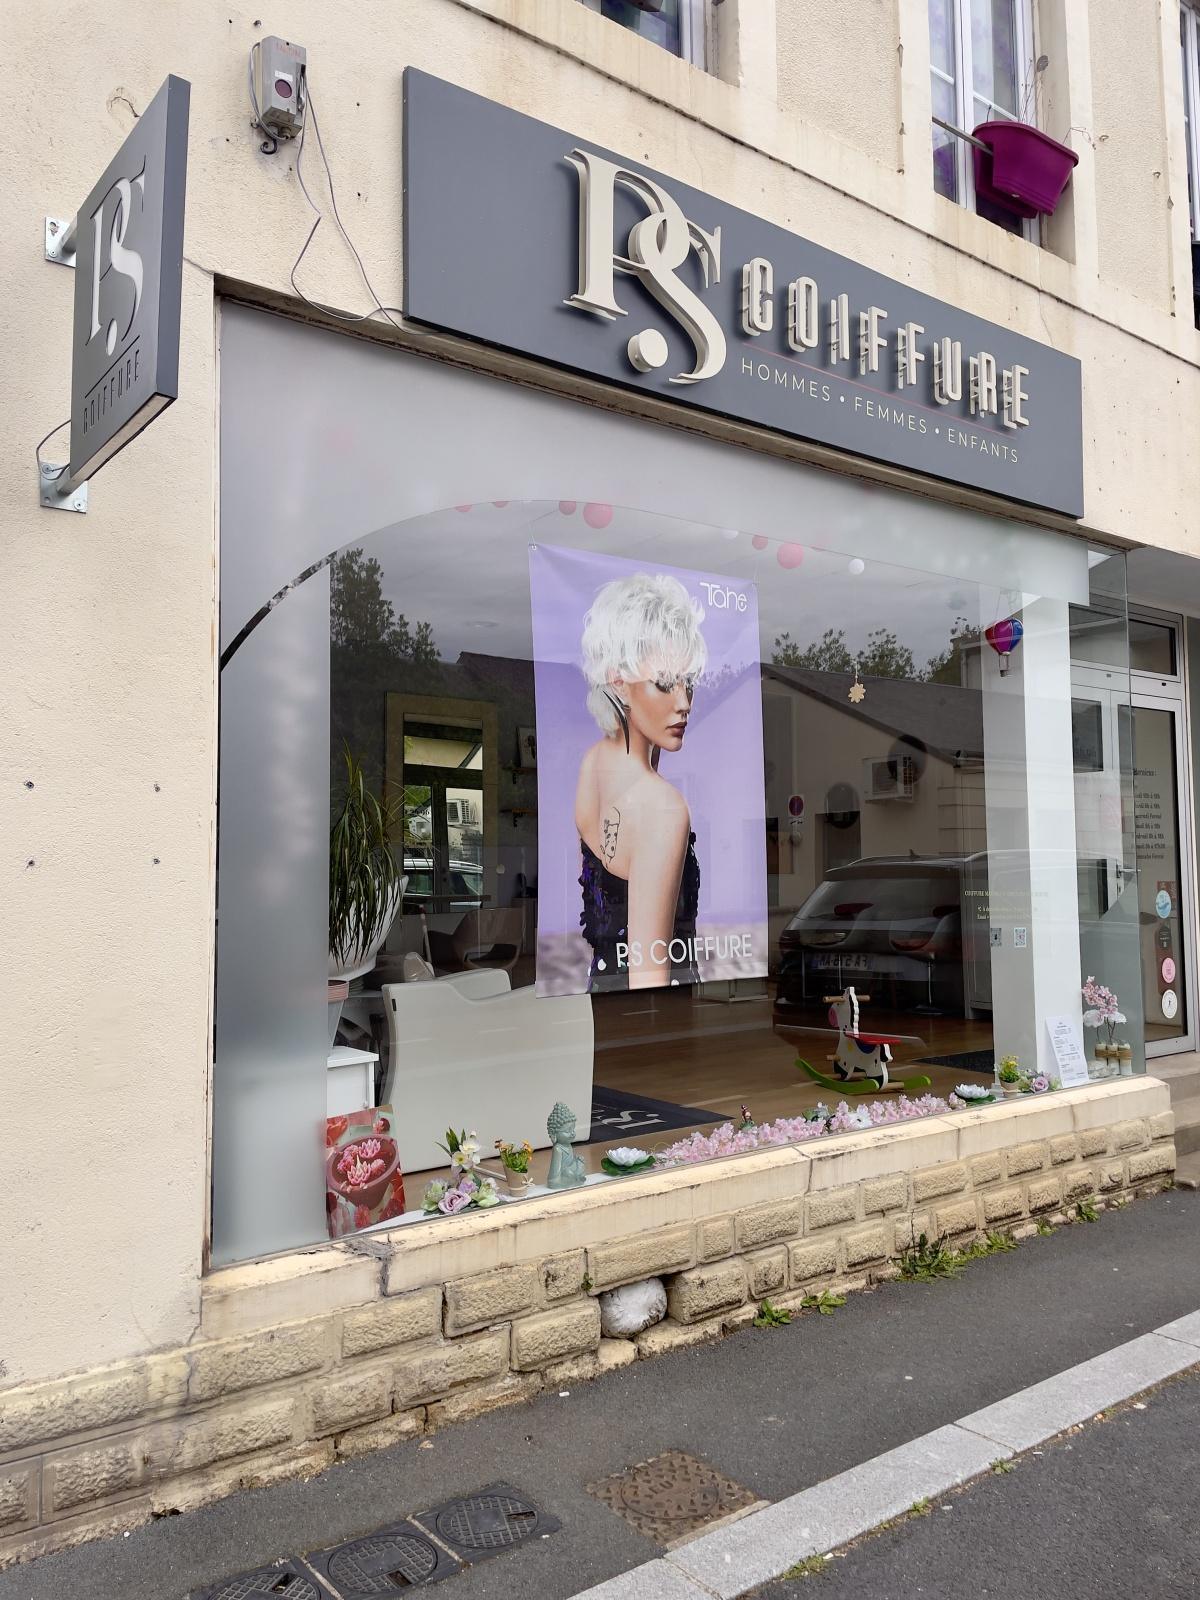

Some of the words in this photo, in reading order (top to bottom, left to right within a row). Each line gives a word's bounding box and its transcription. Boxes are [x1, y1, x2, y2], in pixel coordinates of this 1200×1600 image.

[741, 257, 1031, 430] COIFFURE
[741, 356, 831, 403] HOMMES
[854, 396, 929, 435] FEMMES
[947, 428, 1020, 465] ENFANTS
[699, 582, 748, 612] Tahe
[650, 933, 753, 965] COIFFURE
